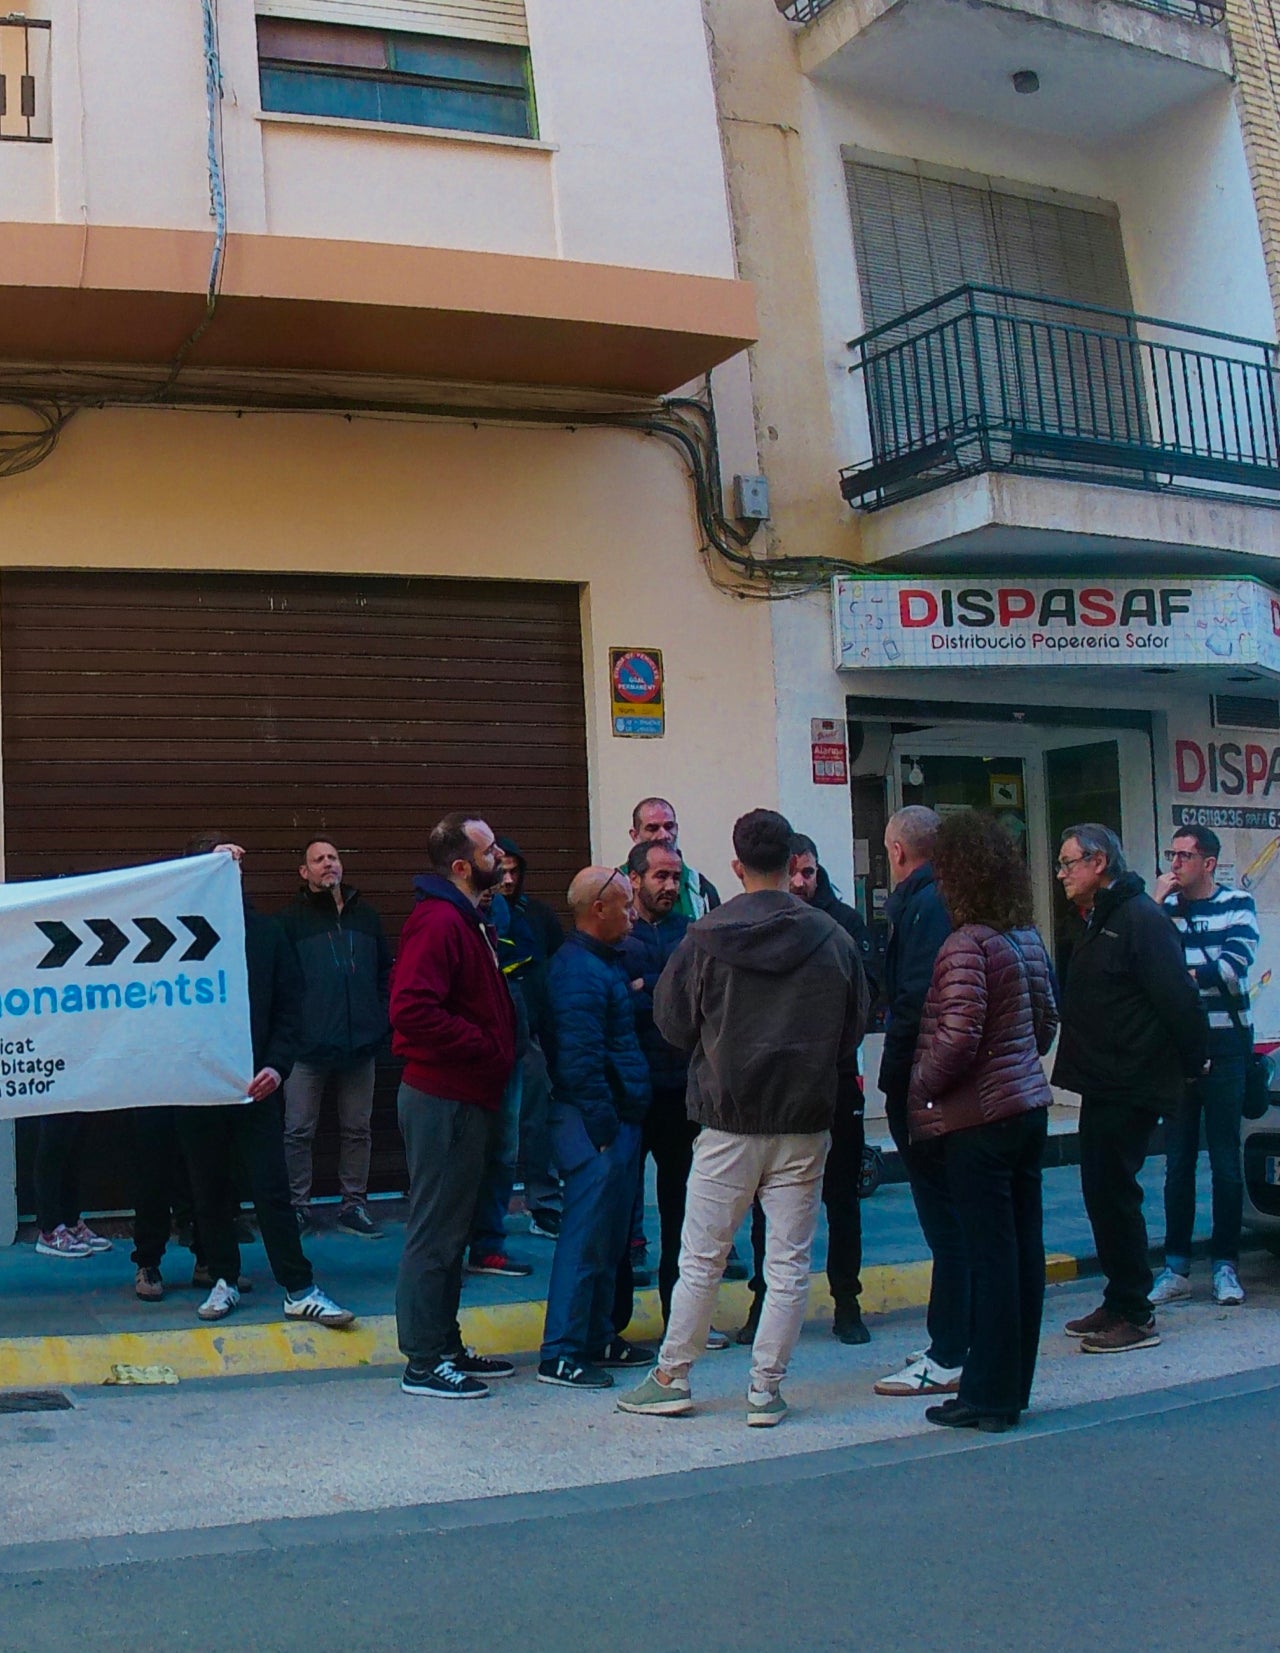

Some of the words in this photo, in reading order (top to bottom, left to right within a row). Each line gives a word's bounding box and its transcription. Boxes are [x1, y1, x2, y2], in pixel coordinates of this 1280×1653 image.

[898, 588, 1193, 628] DISPASAF
[931, 633, 1026, 650] Distribució
[1031, 632, 1120, 651] Papereria
[1125, 632, 1170, 649] Safor
[5, 1077, 56, 1097] Safor
